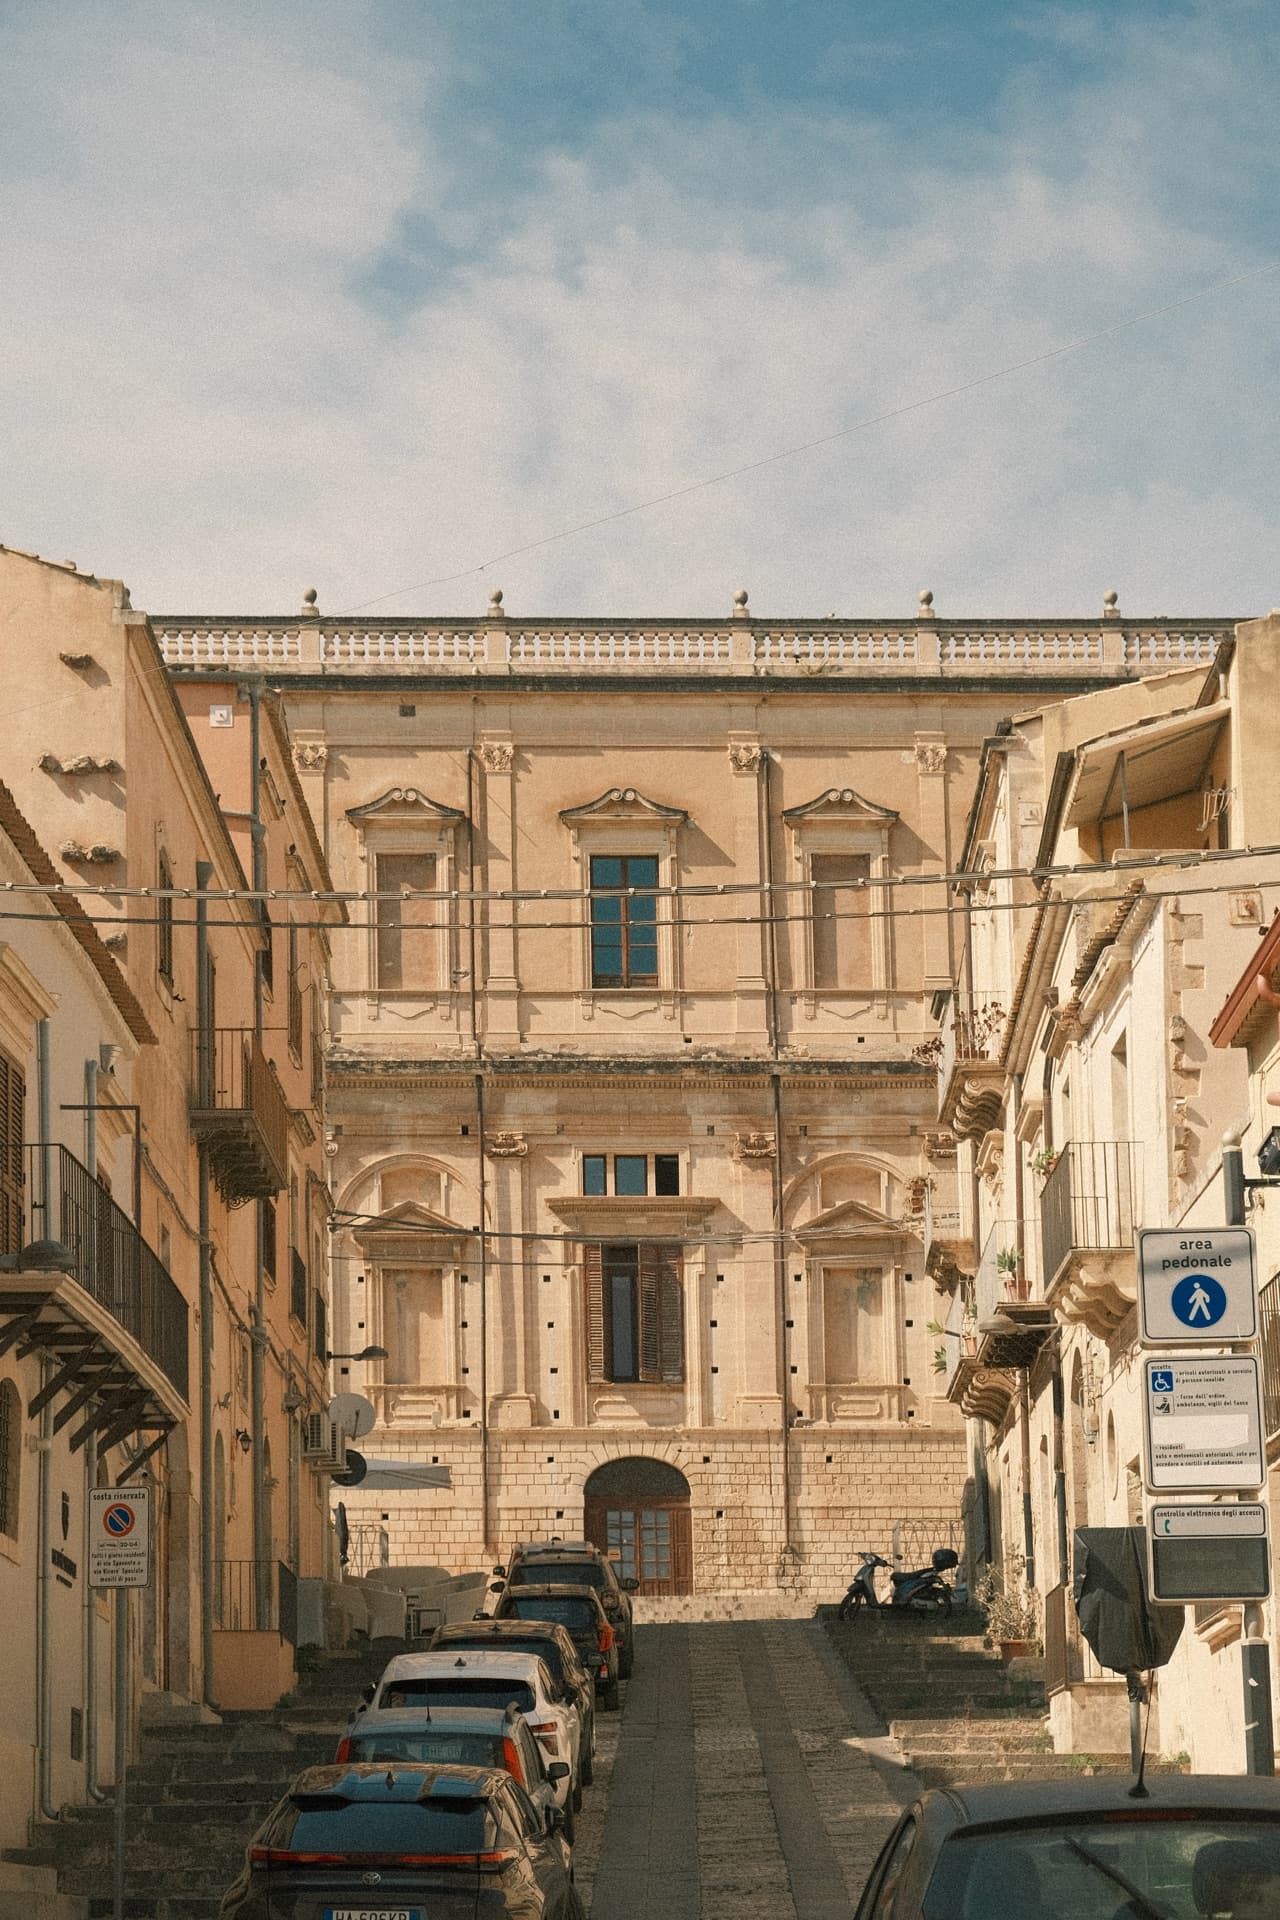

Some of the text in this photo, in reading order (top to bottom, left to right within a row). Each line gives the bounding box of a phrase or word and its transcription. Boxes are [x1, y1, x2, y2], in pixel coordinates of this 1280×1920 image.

[1180, 1240, 1213, 1250] area
[1162, 1255, 1232, 1271] pedonale
[93, 1490, 145, 1500] sosta riservata
[1222, 1509, 1238, 1518] degli
